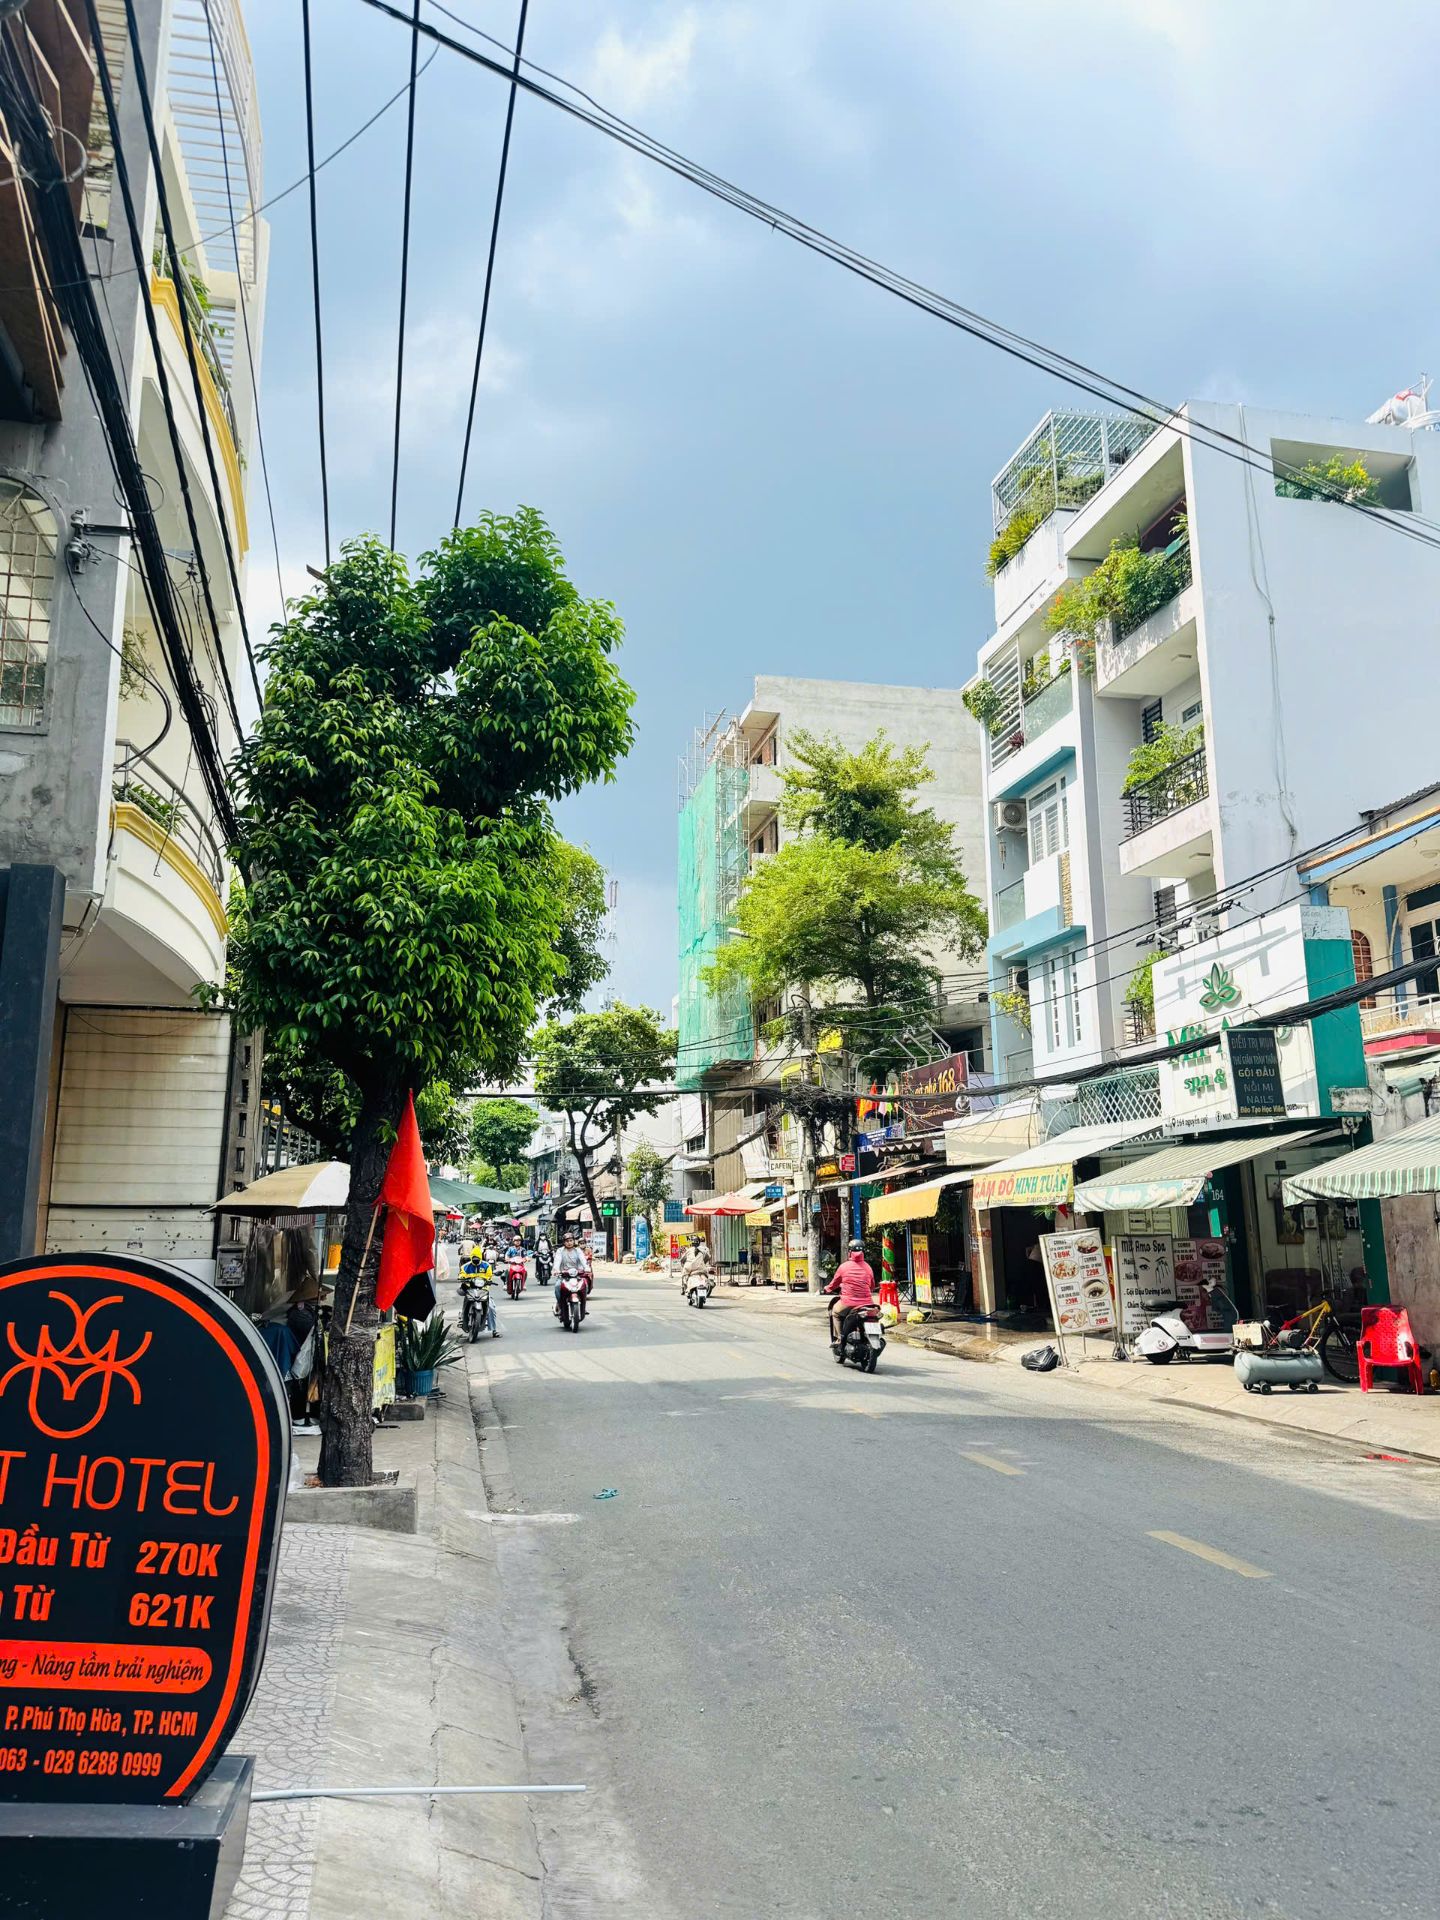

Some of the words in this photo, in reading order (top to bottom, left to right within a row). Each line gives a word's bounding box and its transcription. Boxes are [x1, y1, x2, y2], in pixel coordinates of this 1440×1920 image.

[938, 1068, 956, 1094] 168
[1184, 1075, 1209, 1093] spa
[1238, 1067, 1254, 1079] GỘI
[1246, 1095, 1274, 1104] NAILS
[1015, 1175, 1038, 1194] MINH
[1211, 1189, 1224, 1201] 164
[1135, 1239, 1151, 1252] Amo
[1153, 1239, 1166, 1252] Spa
[43, 1453, 239, 1517] HOTEL
[0, 1523, 59, 1567] Đầu
[70, 1531, 112, 1569] Từ
[135, 1541, 222, 1577] 270K
[14, 1584, 55, 1621] Từ
[128, 1592, 215, 1629] 621K
[31, 1653, 76, 1681] Nâng
[78, 1651, 110, 1678] tầm
[113, 1655, 144, 1679] trải
[145, 1658, 205, 1685] nghiệm
[57, 1706, 87, 1737] Thọ
[89, 1708, 128, 1737] Hòa,
[133, 1709, 154, 1735] TP.
[158, 1711, 199, 1737] HCM
[43, 1750, 75, 1774] 028
[77, 1751, 119, 1775] 6288
[121, 1752, 163, 1776] 0999
